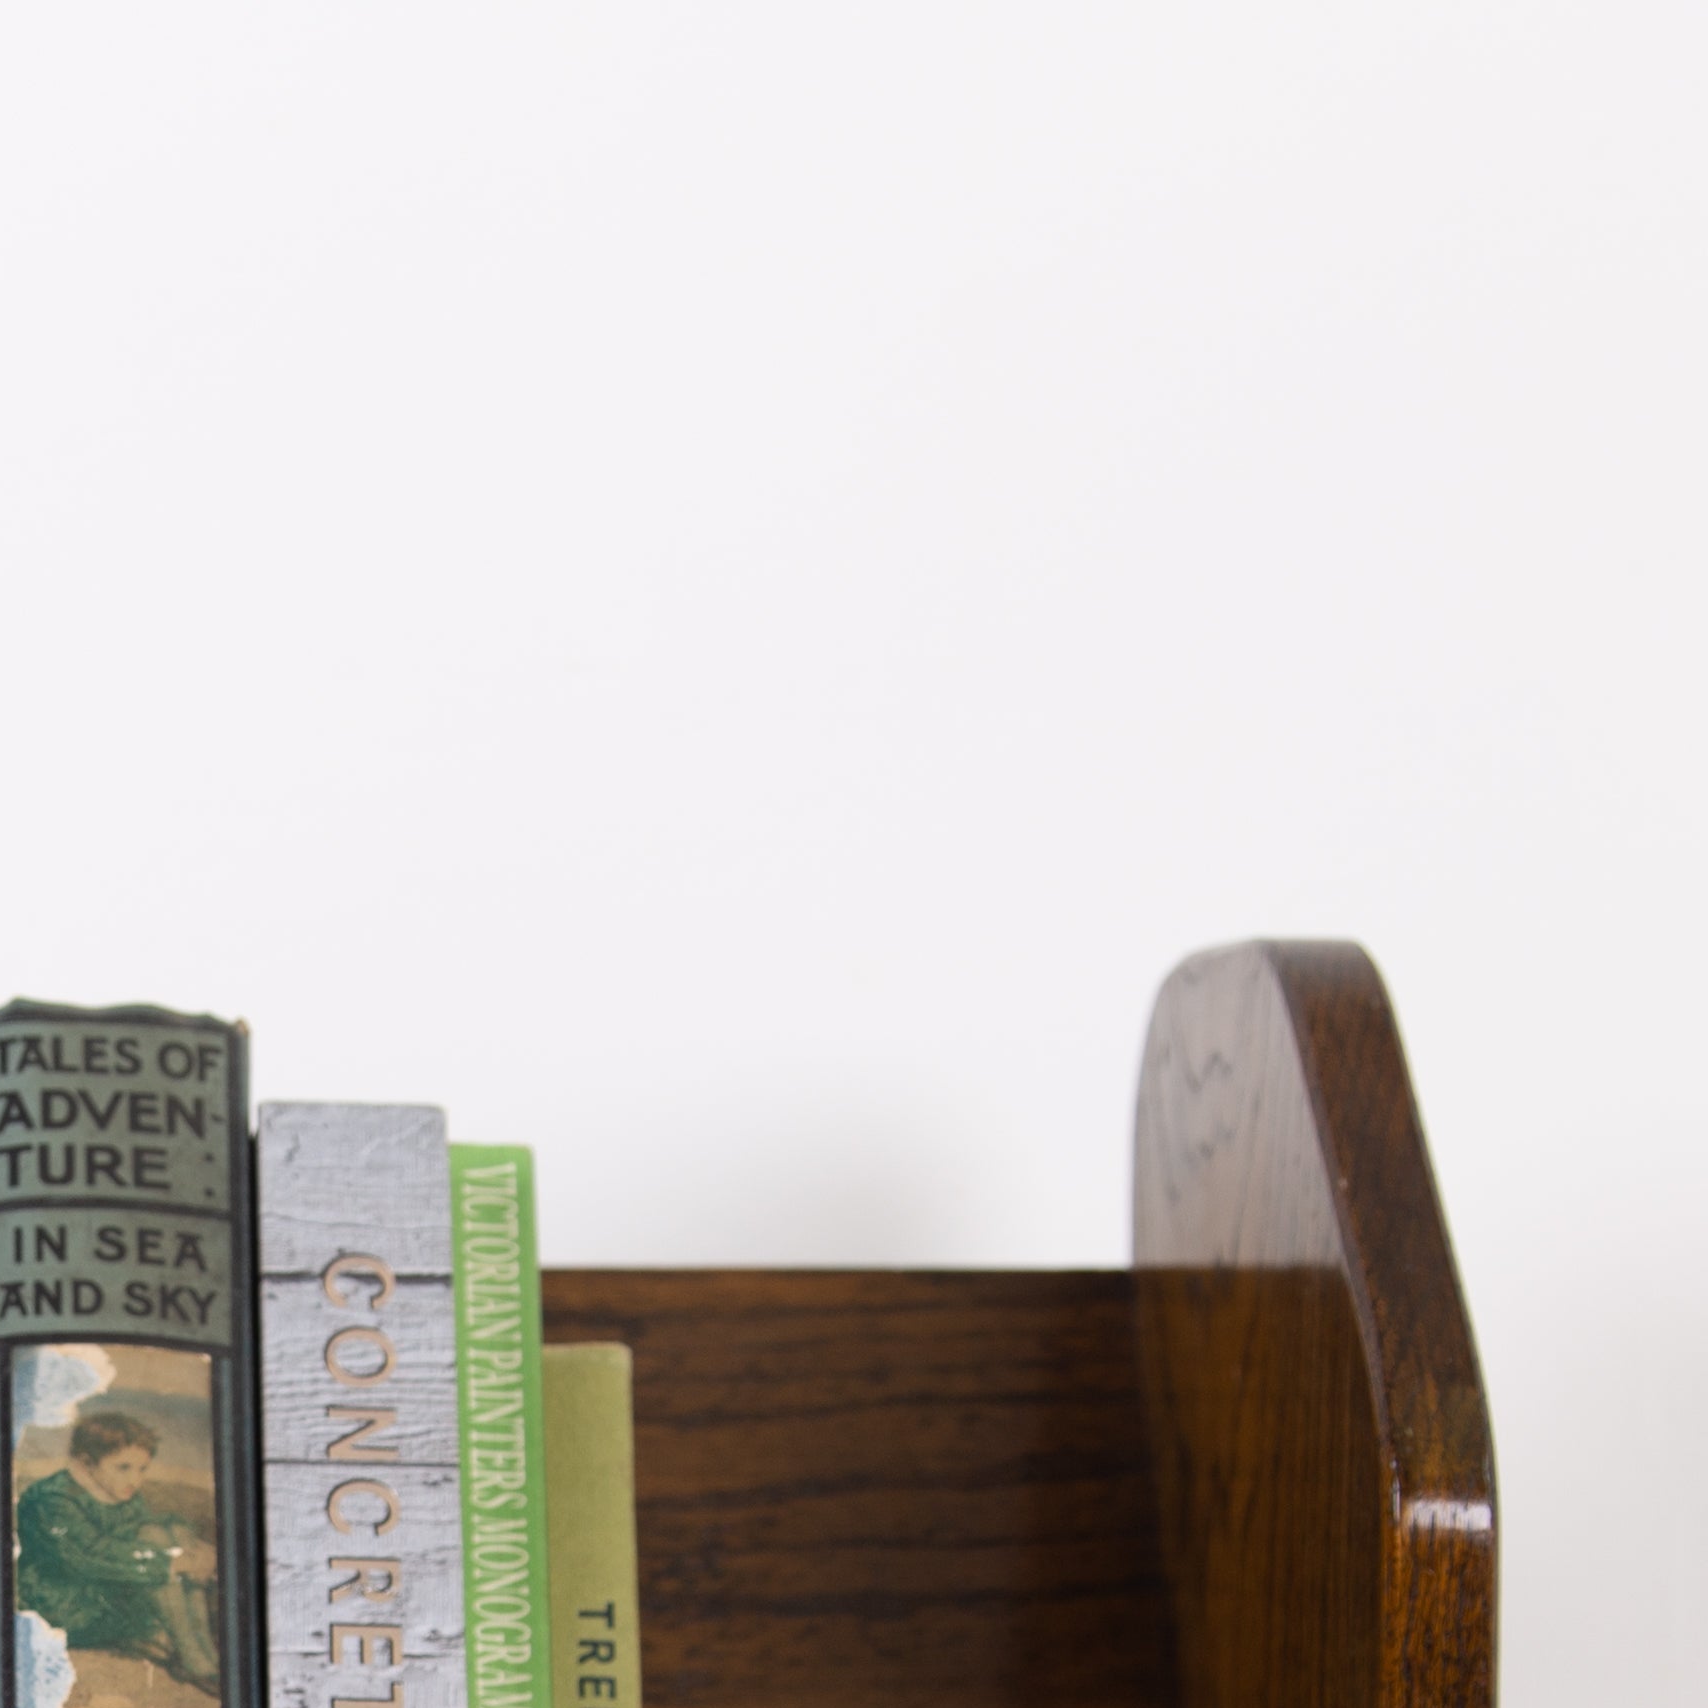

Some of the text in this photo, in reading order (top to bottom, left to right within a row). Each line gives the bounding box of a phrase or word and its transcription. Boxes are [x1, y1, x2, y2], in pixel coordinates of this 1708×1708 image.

[157, 1040, 223, 1082] OF
[11, 1223, 208, 1274] IN SEA
[461, 1162, 523, 1341] VICTORIAN
[122, 1280, 217, 1327] SKY
[466, 1348, 528, 1511] PAINTERS
